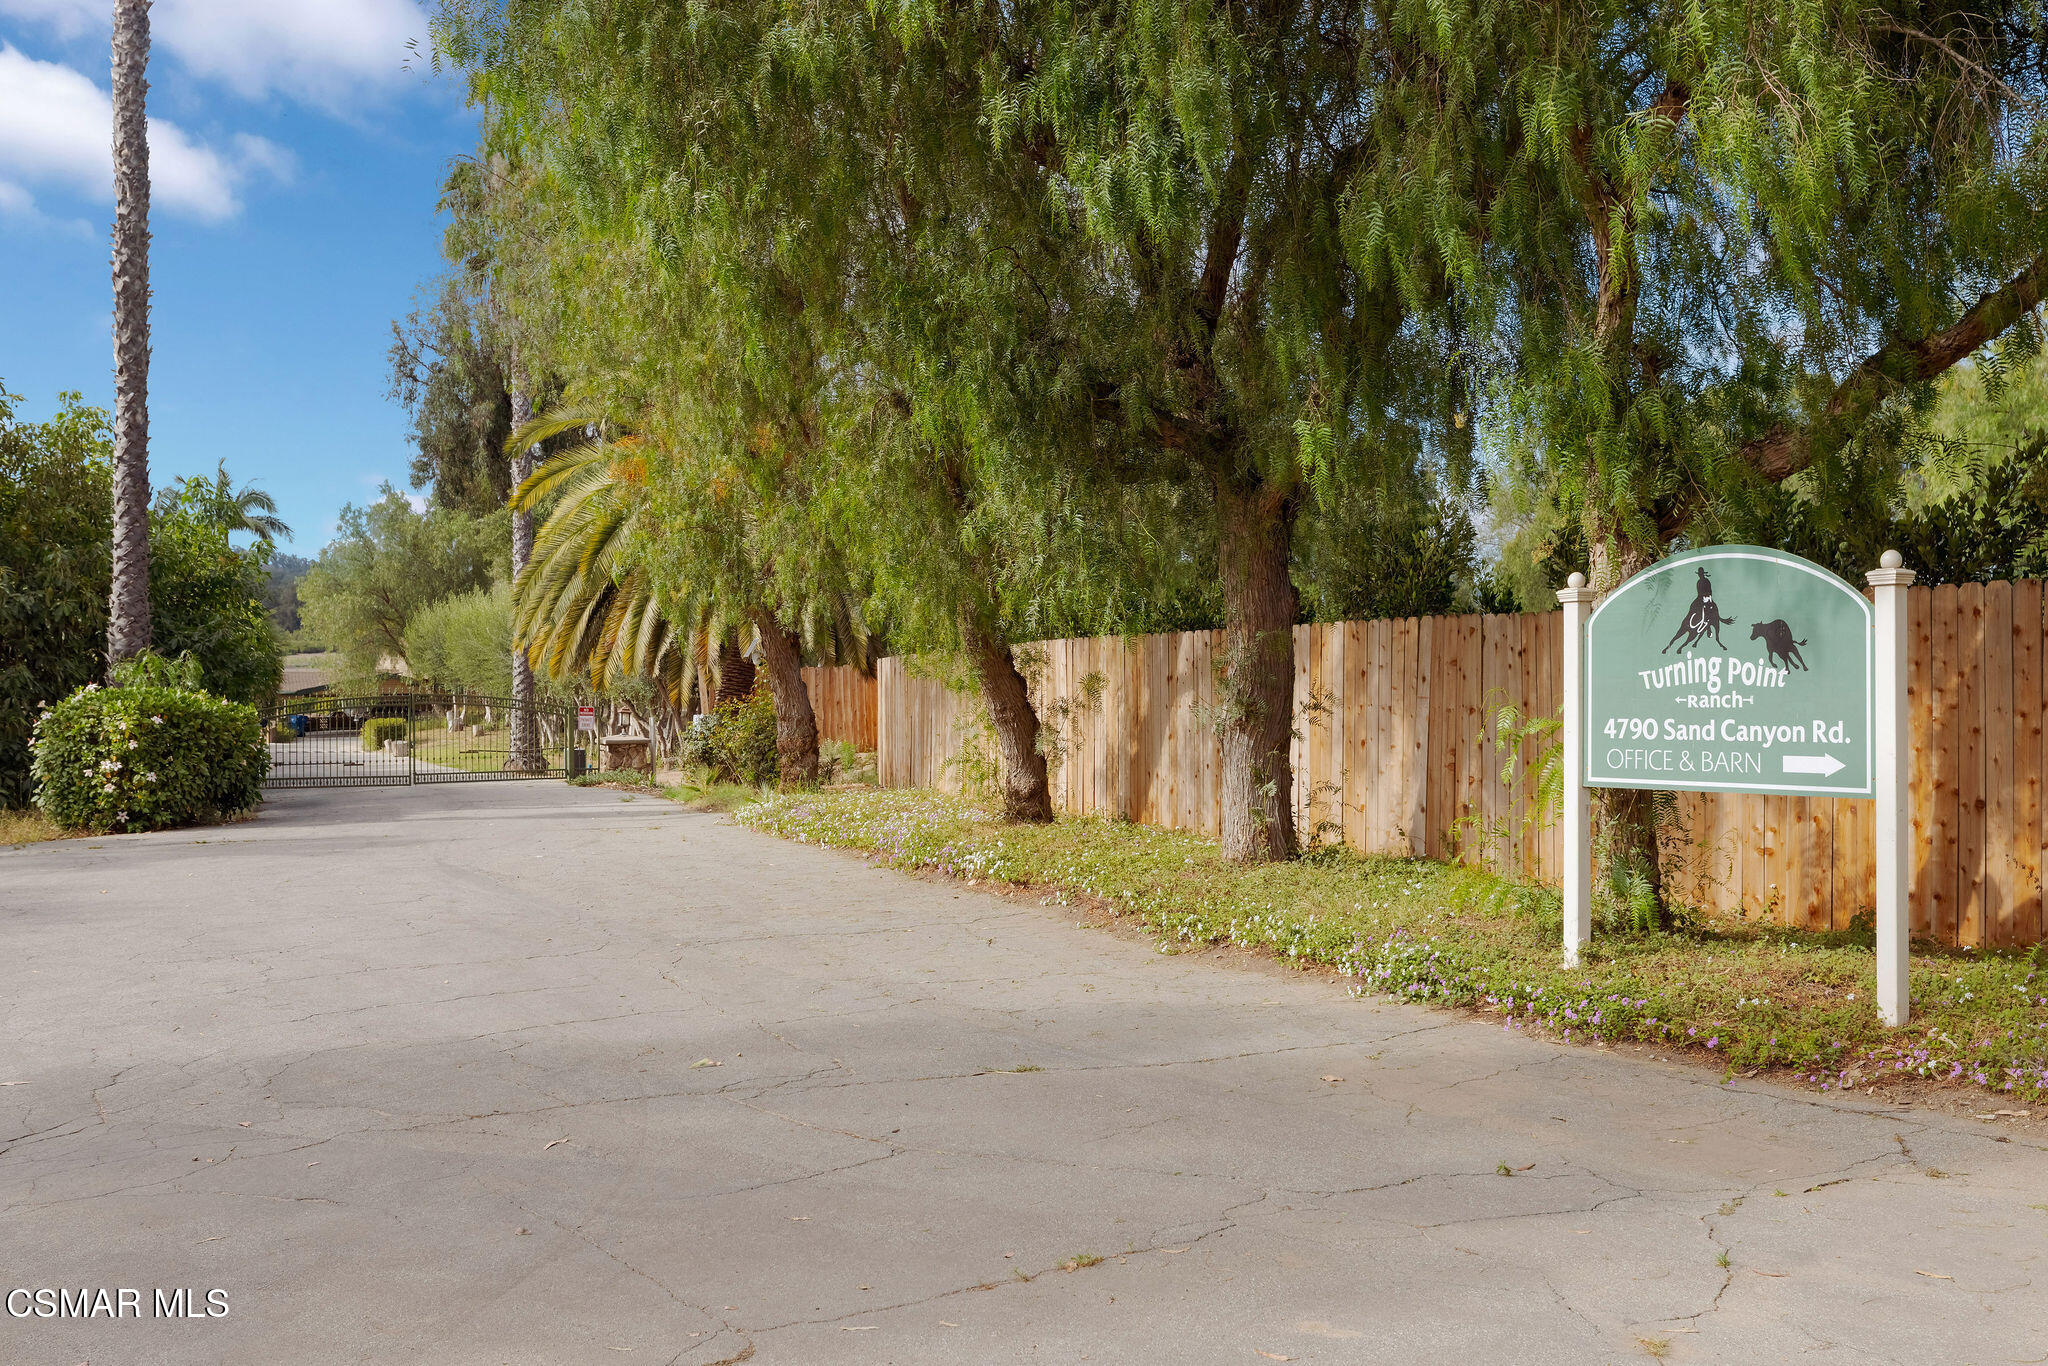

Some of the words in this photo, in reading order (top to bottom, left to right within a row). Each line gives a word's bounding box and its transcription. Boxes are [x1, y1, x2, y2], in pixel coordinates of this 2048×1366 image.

[1638, 651, 1722, 693] Turning
[1728, 657, 1789, 688] Point
[1687, 690, 1744, 708] Ranch
[1604, 718, 1658, 740] 4790
[1664, 719, 1715, 741] Sand
[1721, 720, 1805, 748] Canyon
[1812, 720, 1851, 744] Rd.
[1606, 748, 1673, 771] OFFICE
[1680, 750, 1695, 772] &
[1701, 752, 1761, 774] BARN
